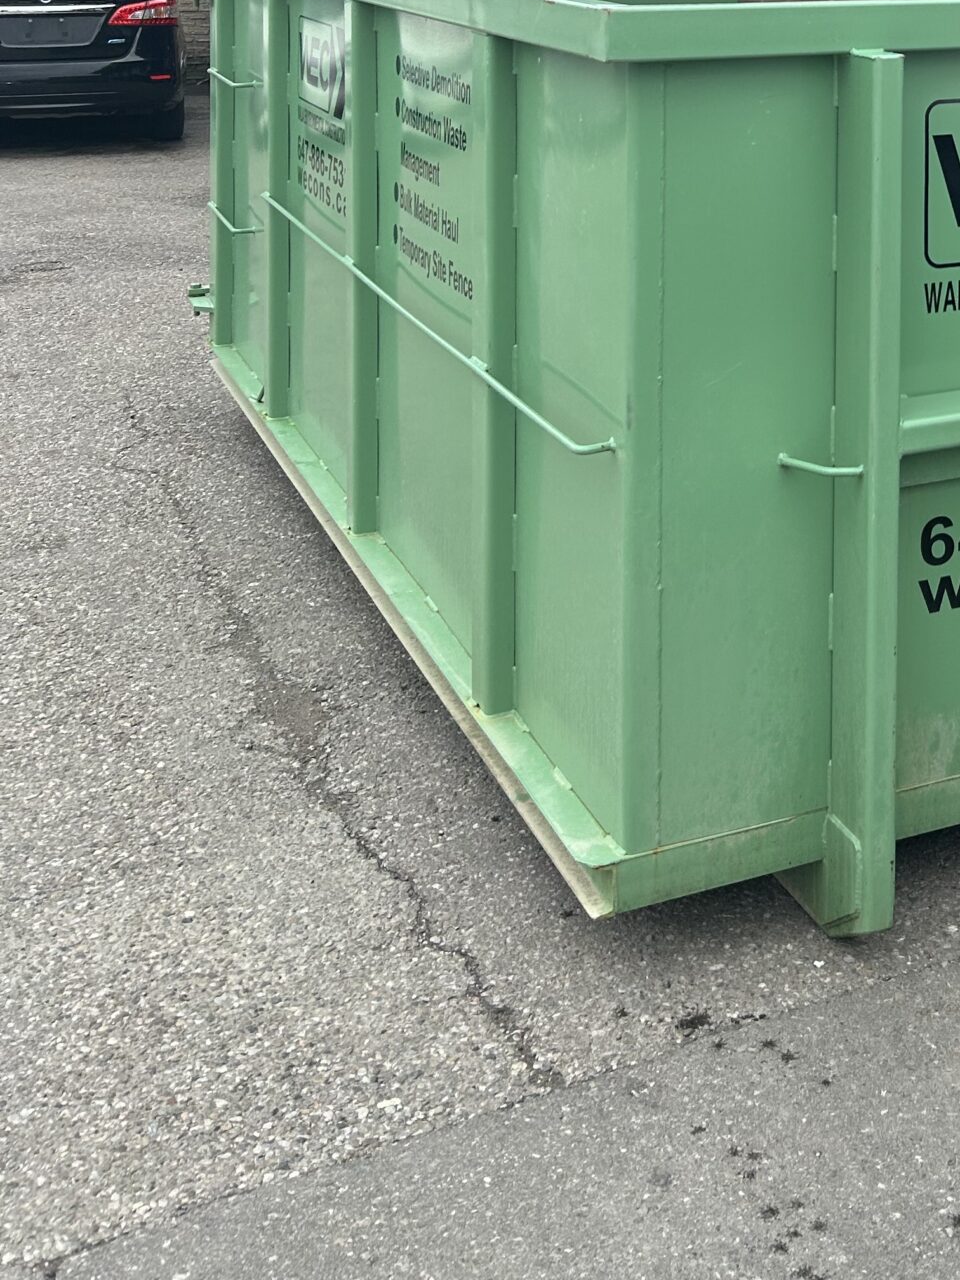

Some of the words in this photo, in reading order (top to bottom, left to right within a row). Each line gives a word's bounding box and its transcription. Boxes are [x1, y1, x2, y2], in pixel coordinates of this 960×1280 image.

[402, 55, 430, 89] Selective
[431, 65, 471, 105] Demolition
[401, 98, 441, 141] Construction
[443, 116, 467, 152] Waste
[298, 135, 346, 188] 647-886-753
[401, 141, 440, 187] Management
[400, 183, 412, 215] Bulk
[414, 192, 439, 232] Material
[441, 208, 459, 245] Haul
[399, 225, 431, 279] Temporary
[432, 250, 446, 283] Site
[448, 260, 473, 300] Fence
